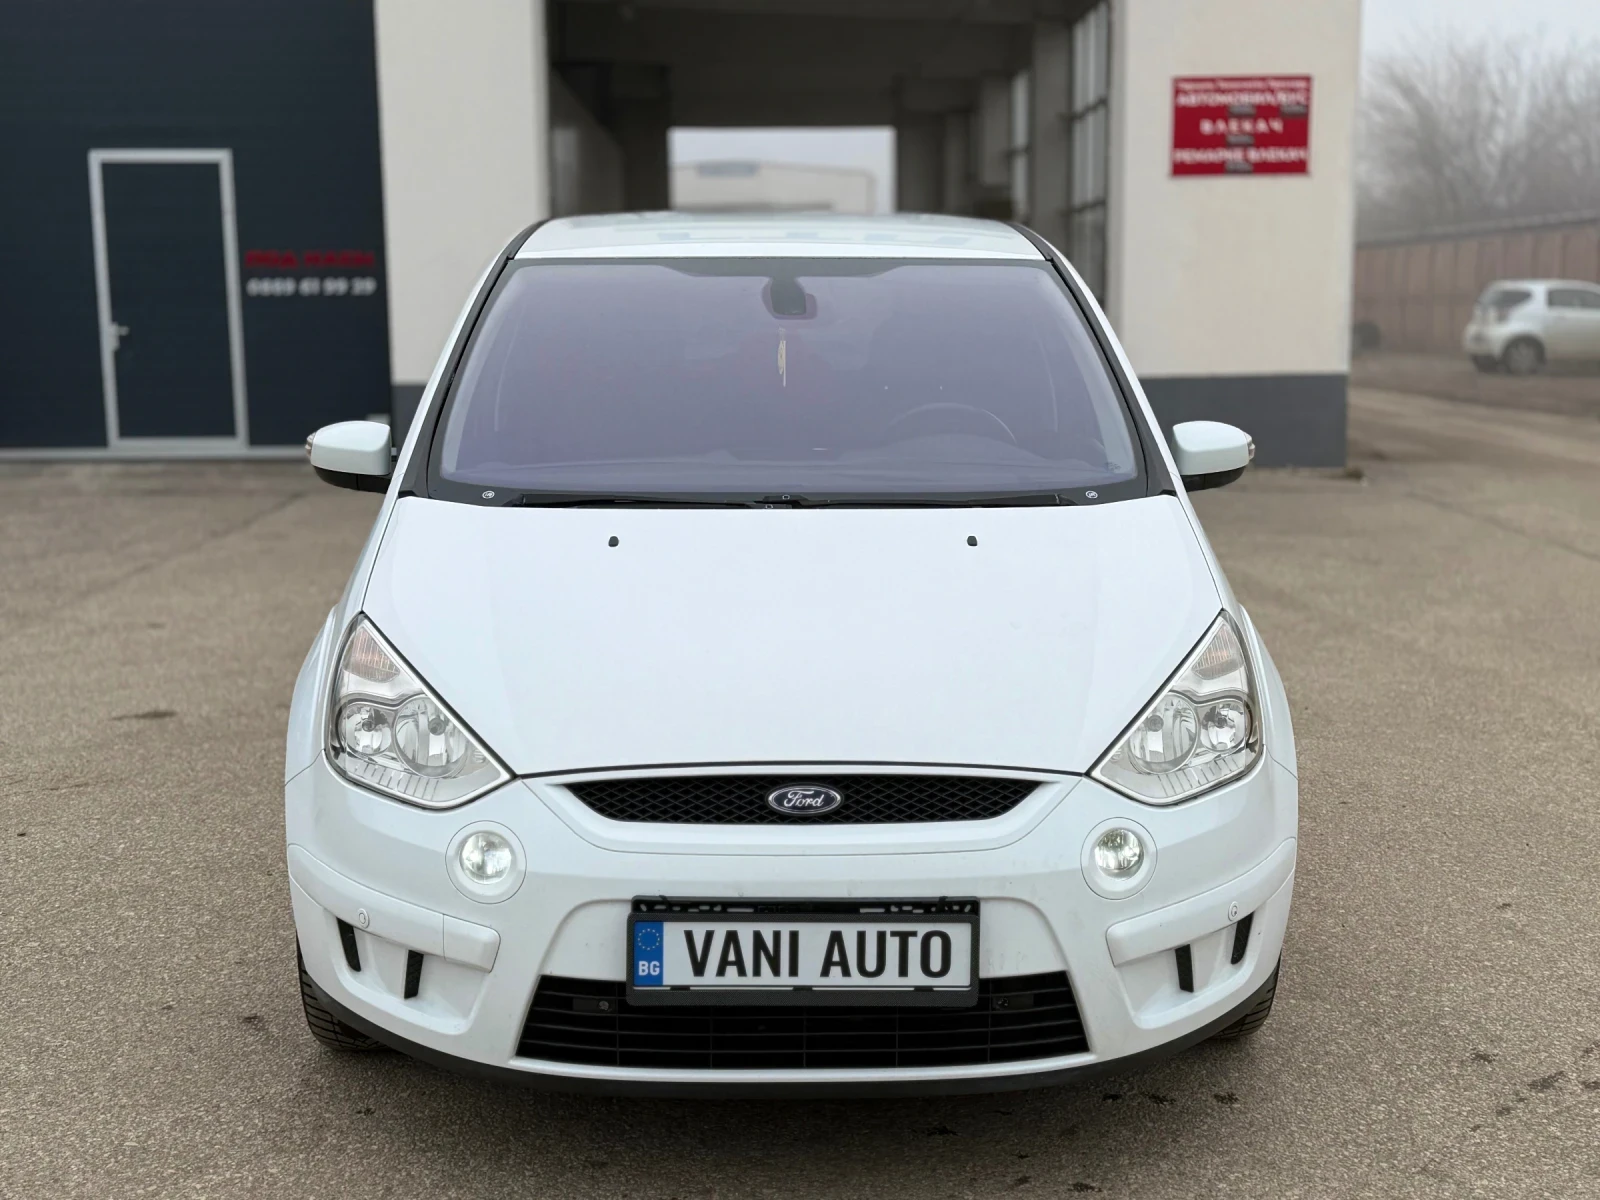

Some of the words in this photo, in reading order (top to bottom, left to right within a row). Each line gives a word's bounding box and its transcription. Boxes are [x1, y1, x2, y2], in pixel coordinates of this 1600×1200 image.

[1200, 118, 1283, 135] ВЛЕКАЧ
[784, 790, 825, 807] Ford
[683, 929, 799, 978] VANI
[820, 929, 952, 978] AUTO
[638, 960, 660, 976] BG
